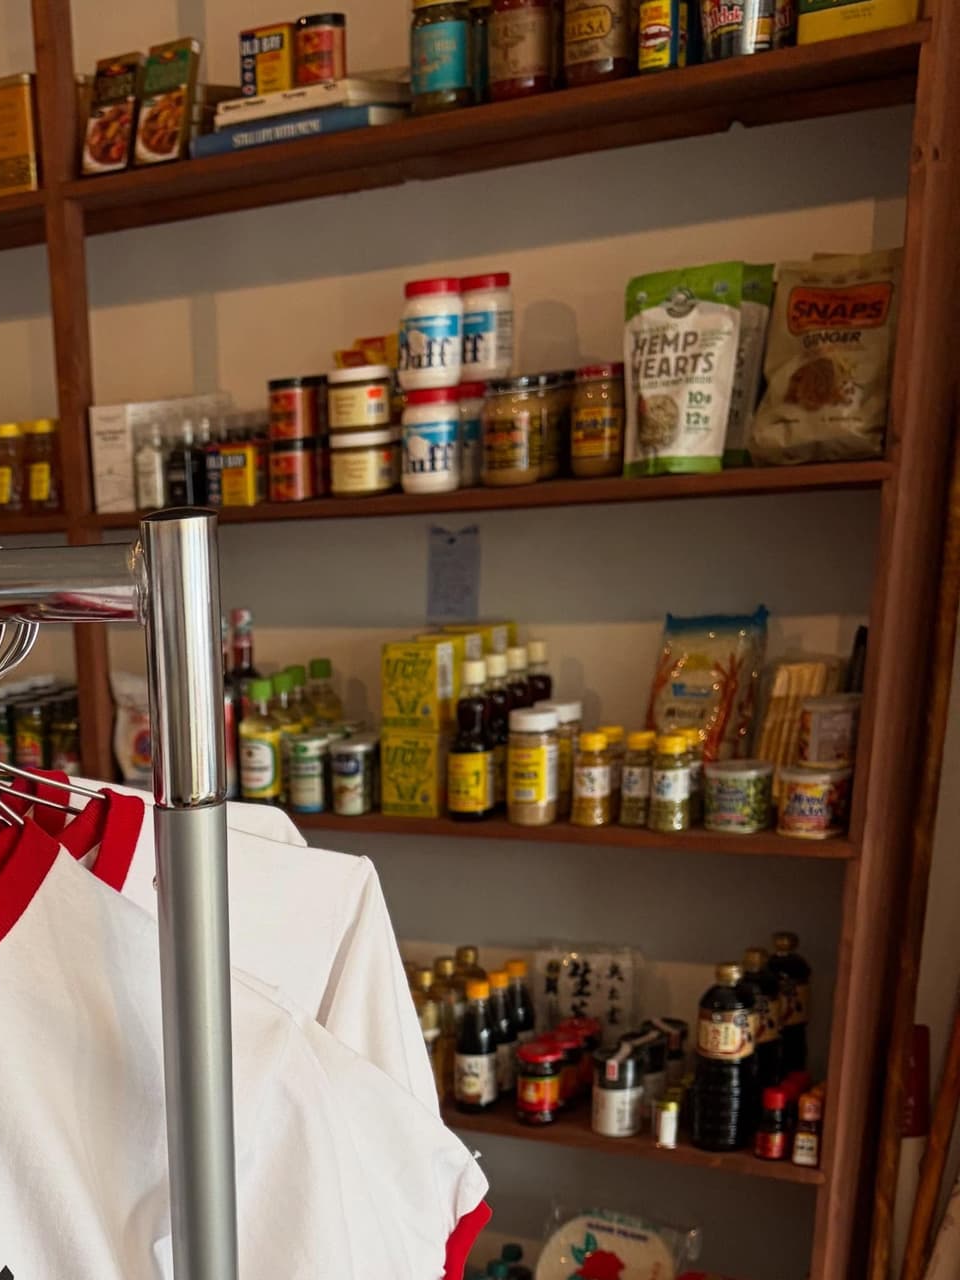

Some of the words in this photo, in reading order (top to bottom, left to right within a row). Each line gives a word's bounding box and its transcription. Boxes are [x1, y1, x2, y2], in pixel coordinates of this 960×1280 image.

[793, 299, 885, 320] SNAPS
[632, 331, 699, 357] HEMP
[631, 352, 715, 380] HEARTS
